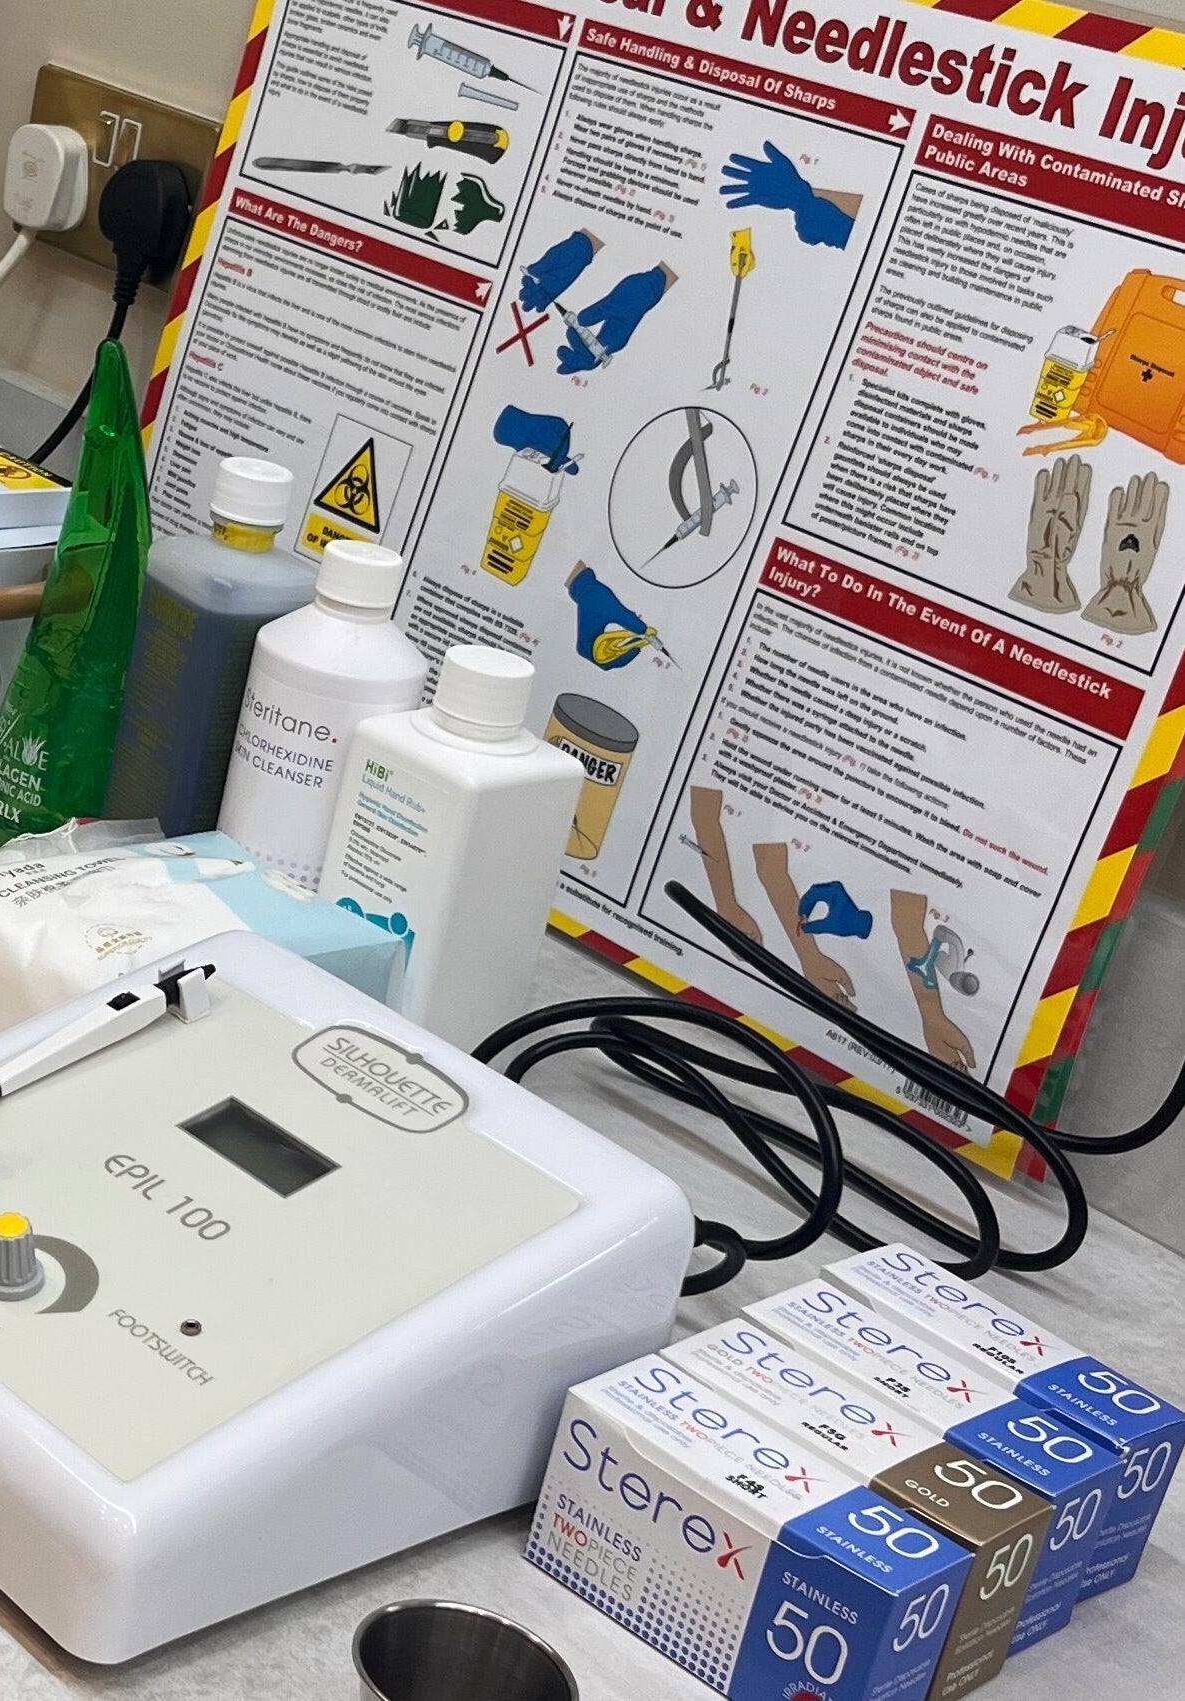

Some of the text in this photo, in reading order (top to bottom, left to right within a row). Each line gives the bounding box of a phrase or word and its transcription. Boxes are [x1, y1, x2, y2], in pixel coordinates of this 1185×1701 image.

[586, 28, 837, 111] Safe Handling & Disposal Of Sharps
[741, 0, 1088, 129] Needlestick
[1098, 76, 1185, 170] Inj
[925, 146, 1028, 187] Public Areas
[932, 124, 1185, 209] Dealing With Contaminated Sh
[236, 197, 363, 253] What Are The Dangers?
[856, 347, 979, 395] contaminated object and safe
[865, 321, 914, 345] Precautions
[916, 340, 947, 356] should
[976, 361, 988, 370] on
[908, 351, 940, 368] contact
[941, 362, 960, 374] with
[961, 369, 976, 380] the
[768, 567, 821, 598] Injury?
[776, 546, 1112, 700] What To Do In The Event Of A Needlestick
[238, 722, 335, 772] CHLORHEXIDINE
[252, 755, 323, 789] CLEANSER
[17, 789, 41, 806] ACID
[362, 773, 385, 793] Liquid
[385, 785, 405, 803] Hand
[77, 856, 125, 871] TOWEL
[566, 886, 600, 909] substitute
[602, 904, 612, 915] for
[613, 912, 653, 939] recognised
[320, 1057, 419, 1116] DERMALIFT
[326, 1037, 454, 1114] SILHOUETTE
[103, 1153, 231, 1242] EPIL 100
[867, 1260, 923, 1294] STAINLESS
[787, 1301, 846, 1337] STAINLESS
[881, 1251, 1058, 1357] Sterex
[107, 1309, 214, 1387] FOOTSWITCH
[706, 1343, 743, 1366] GOLD
[801, 1291, 993, 1403] Sterex
[617, 1380, 678, 1420] STAINLESS
[721, 1331, 913, 1447] Sterex
[1048, 1383, 1118, 1427] STAINLESS
[1078, 1370, 1161, 1415] 50
[633, 1368, 830, 1494] Sterex
[800, 1421, 849, 1451] REGULAR
[977, 1432, 1052, 1477] STAINLESS
[1007, 1415, 1093, 1463] 50
[904, 1478, 950, 1508] GOLD
[934, 1459, 1023, 1510] 50
[1117, 1441, 1172, 1500] 50
[563, 1419, 754, 1581] Sterex
[1049, 1488, 1102, 1551] 50
[557, 1494, 642, 1562] STAINLESS
[816, 1525, 893, 1574] STAINLESS
[847, 1505, 940, 1559] 50
[547, 1530, 633, 1602] NEEDLES
[979, 1533, 1033, 1601] 50
[782, 1571, 859, 1625] STAINLESS
[893, 1583, 950, 1653] 50
[766, 1600, 848, 1685] 50
